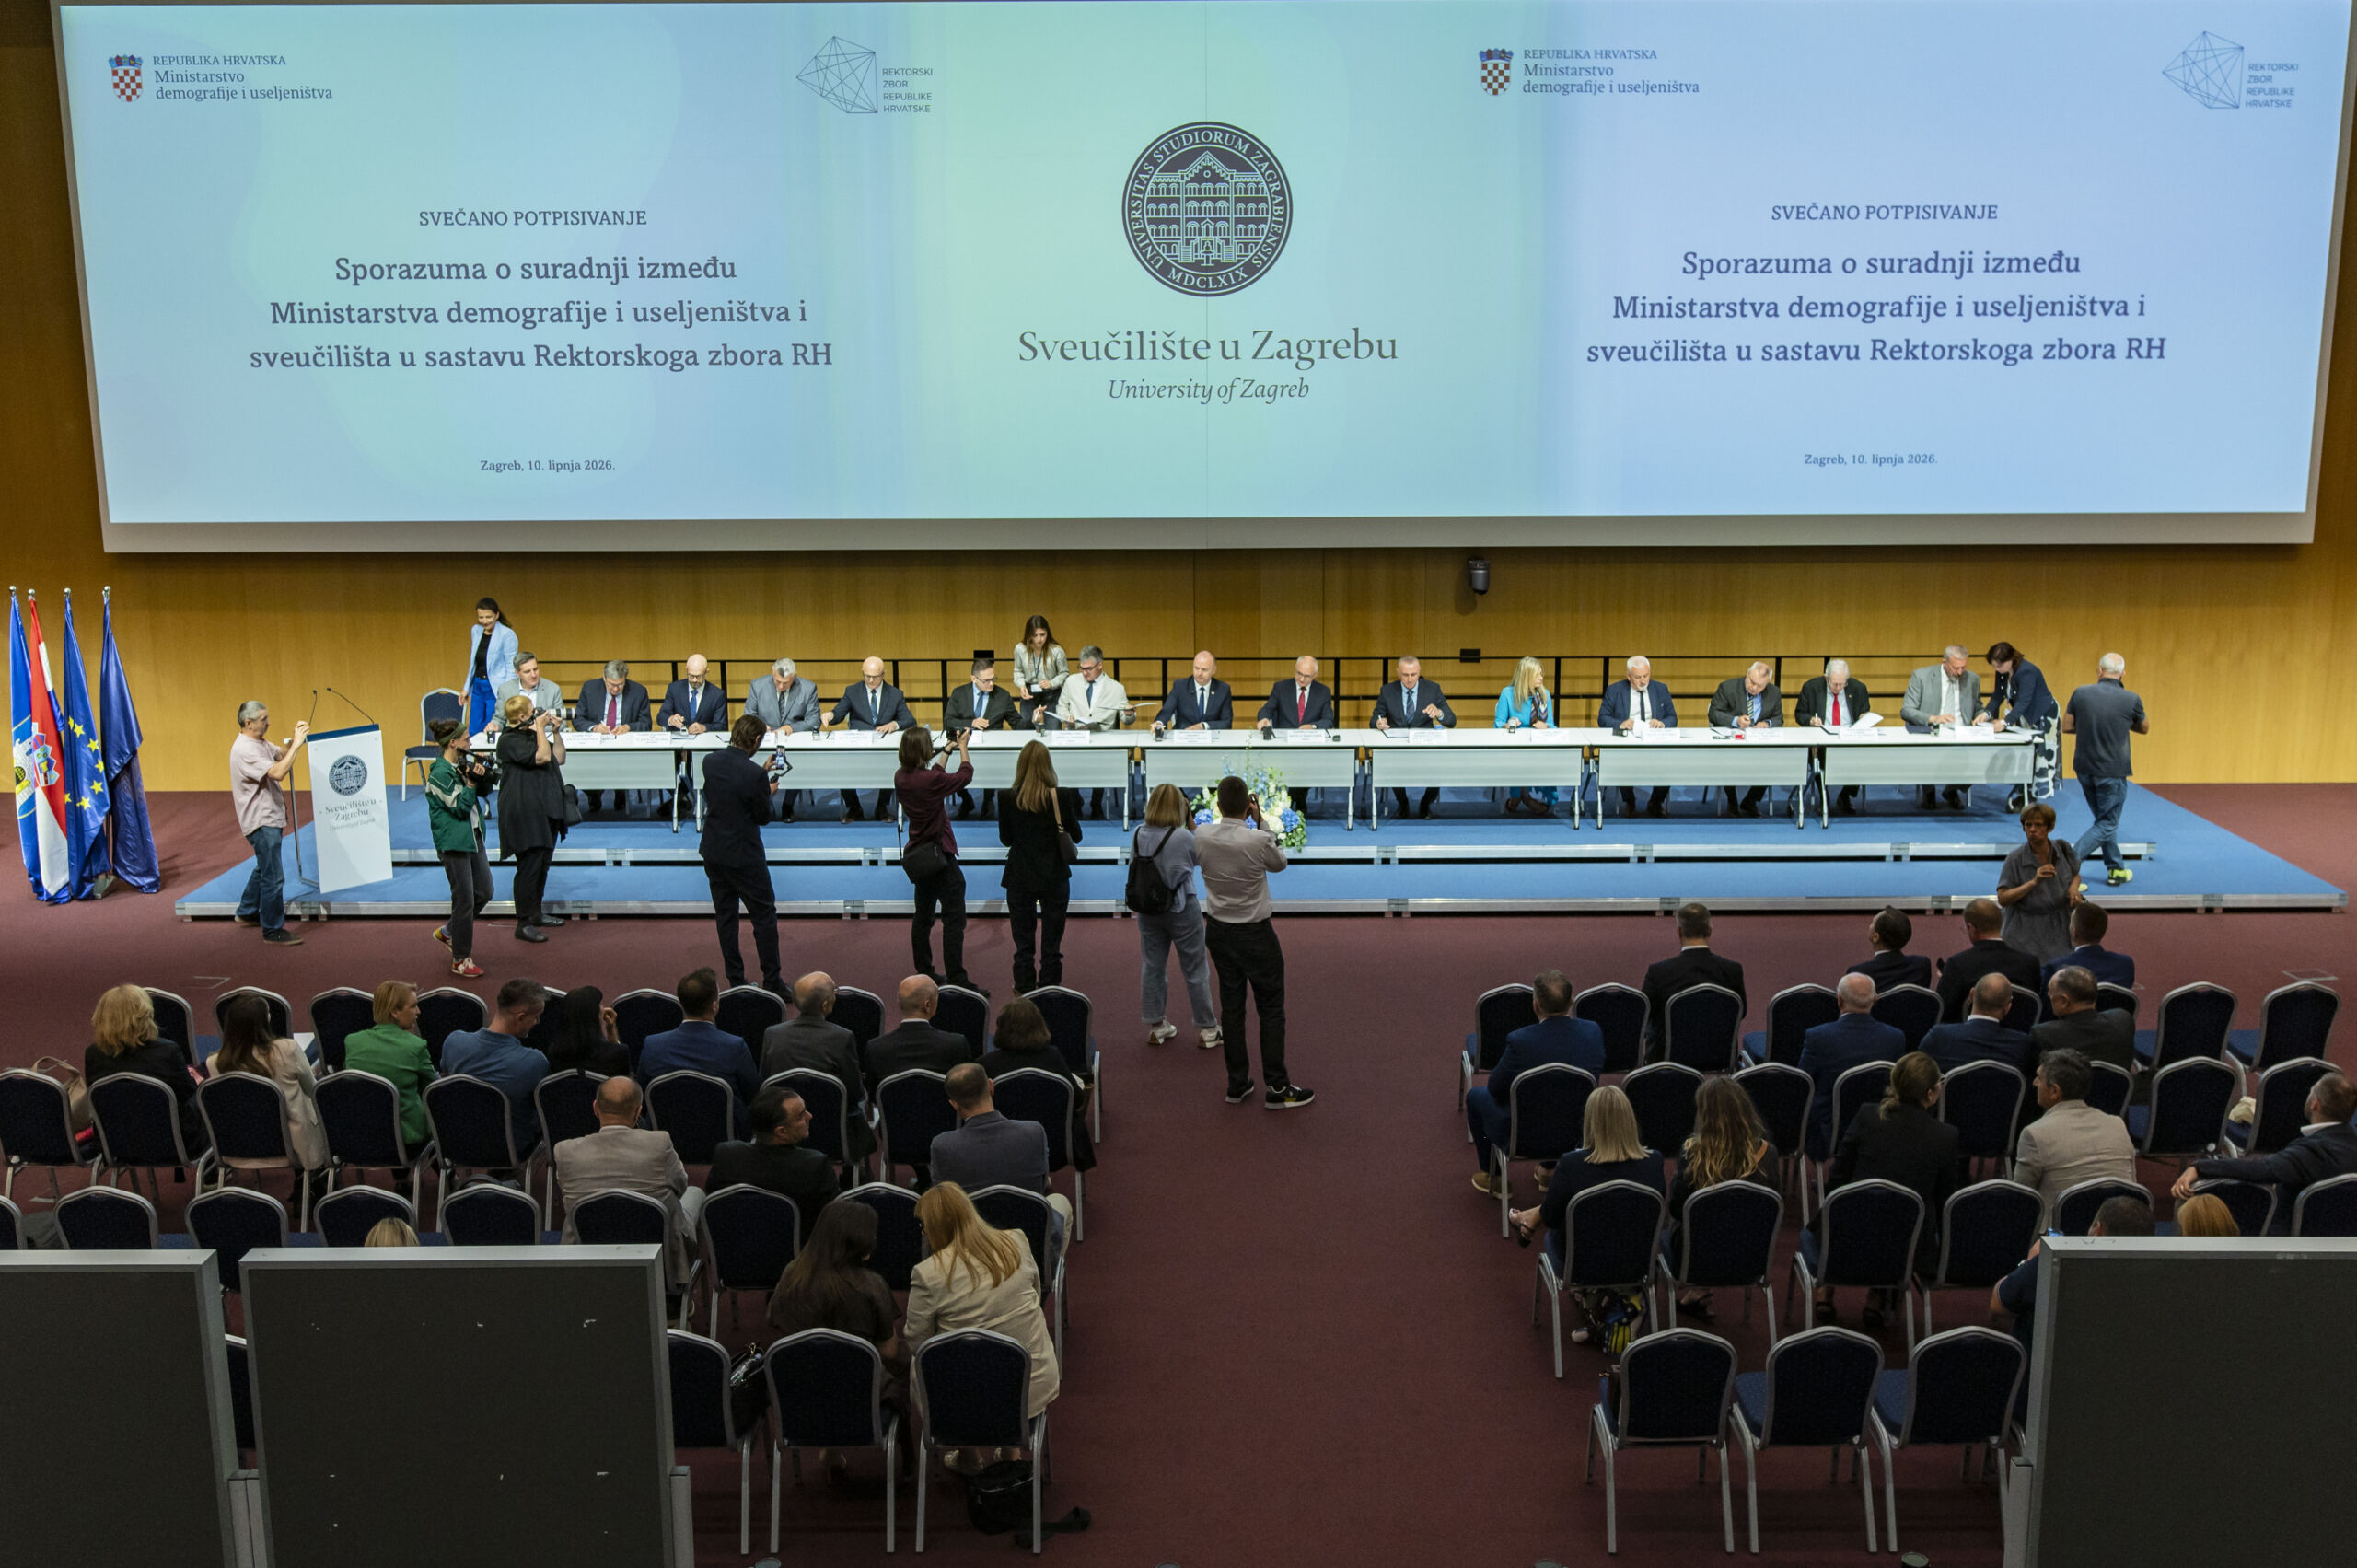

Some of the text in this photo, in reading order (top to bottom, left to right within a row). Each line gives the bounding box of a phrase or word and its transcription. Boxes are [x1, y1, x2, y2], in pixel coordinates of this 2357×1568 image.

[153, 55, 286, 65] REPUBLIKA HRVATSKA
[1524, 49, 1657, 59] REPUBLIKA HRVATSKA
[882, 67, 933, 76] REKTORSKI
[1524, 64, 1613, 76] Ministarstvo
[2248, 63, 2298, 72] REKTORSKI
[155, 70, 244, 83] Ministarstvo
[2247, 75, 2272, 84] ZBOR
[883, 80, 908, 88] ZBOR
[1523, 80, 1699, 96] demografije i useljeništva
[156, 86, 332, 102] demografije i useljeništva
[883, 92, 932, 100] REPUBLIKE
[2247, 87, 2295, 96] REPUBLIKE
[884, 104, 931, 113] HRVATSKE
[2246, 99, 2293, 108] HRVATSKE
[1131, 130, 1285, 269] UNIVERSITAS STUDIORUM ZAGRABIENSIS
[420, 208, 646, 226] SVEČANO POTPISIVANJE
[1771, 203, 1998, 220] SVEČANO POTPISIVANJE
[336, 256, 737, 286] Sporazuma o suradnji između
[1682, 250, 2080, 280] Sporazuma o suradnji između
[1167, 267, 1249, 289] MDCLXIX
[270, 299, 807, 330] Ministarstva demografije i useljeništva i
[1613, 294, 2144, 323] Ministarstva demografije i useljeništva i
[1019, 327, 1398, 370] Sveučilište u Zagrebu
[1587, 338, 2166, 366] sveučilišta u sastavu Rektorskoga zbora RH
[250, 343, 832, 372] sveučilišta u sastavu Rektorskoga zbora RH
[1109, 377, 1309, 404] University of Zagreb
[481, 460, 615, 473] Zagreb, 10. lipnja 2026.
[1805, 454, 1937, 467] Zagreb, 10. lipnja 2026.
